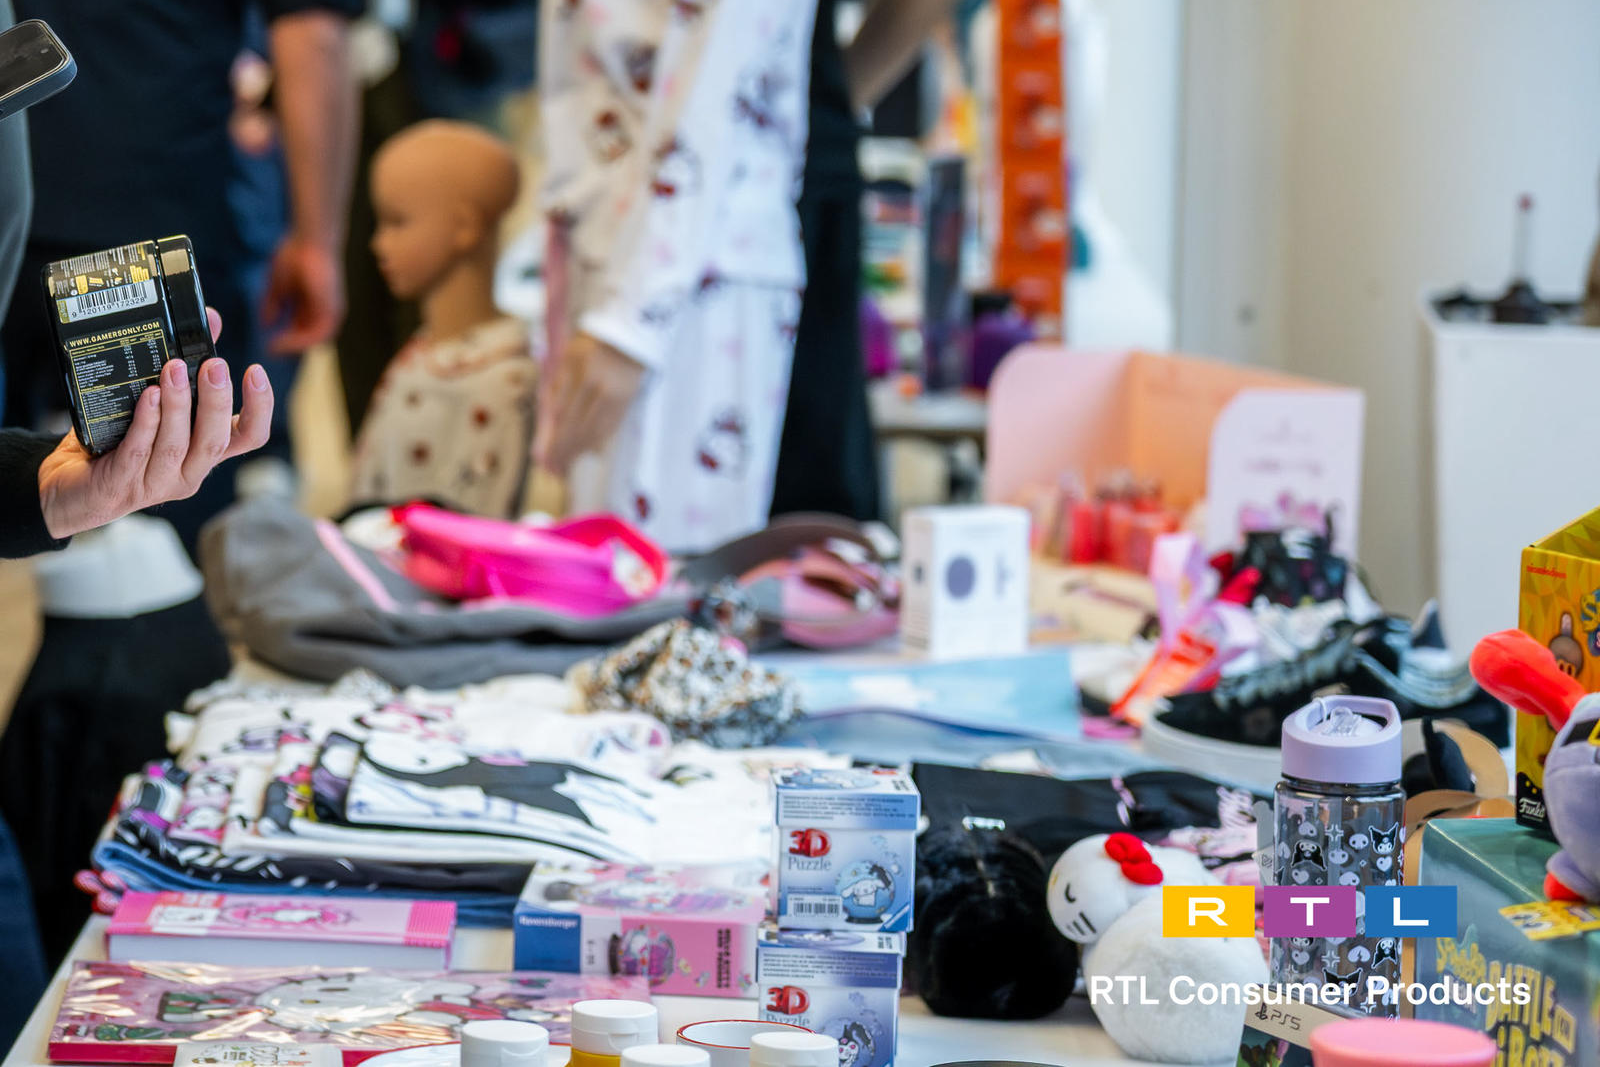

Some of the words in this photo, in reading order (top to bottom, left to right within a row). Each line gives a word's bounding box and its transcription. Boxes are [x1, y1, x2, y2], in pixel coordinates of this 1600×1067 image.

[69, 321, 160, 348] WWW.GAMERSONLY.COM
[789, 828, 832, 858] 3D
[788, 856, 832, 871] Puzzle
[766, 985, 810, 1015] 3D
[1270, 1009, 1302, 1031] PS5
